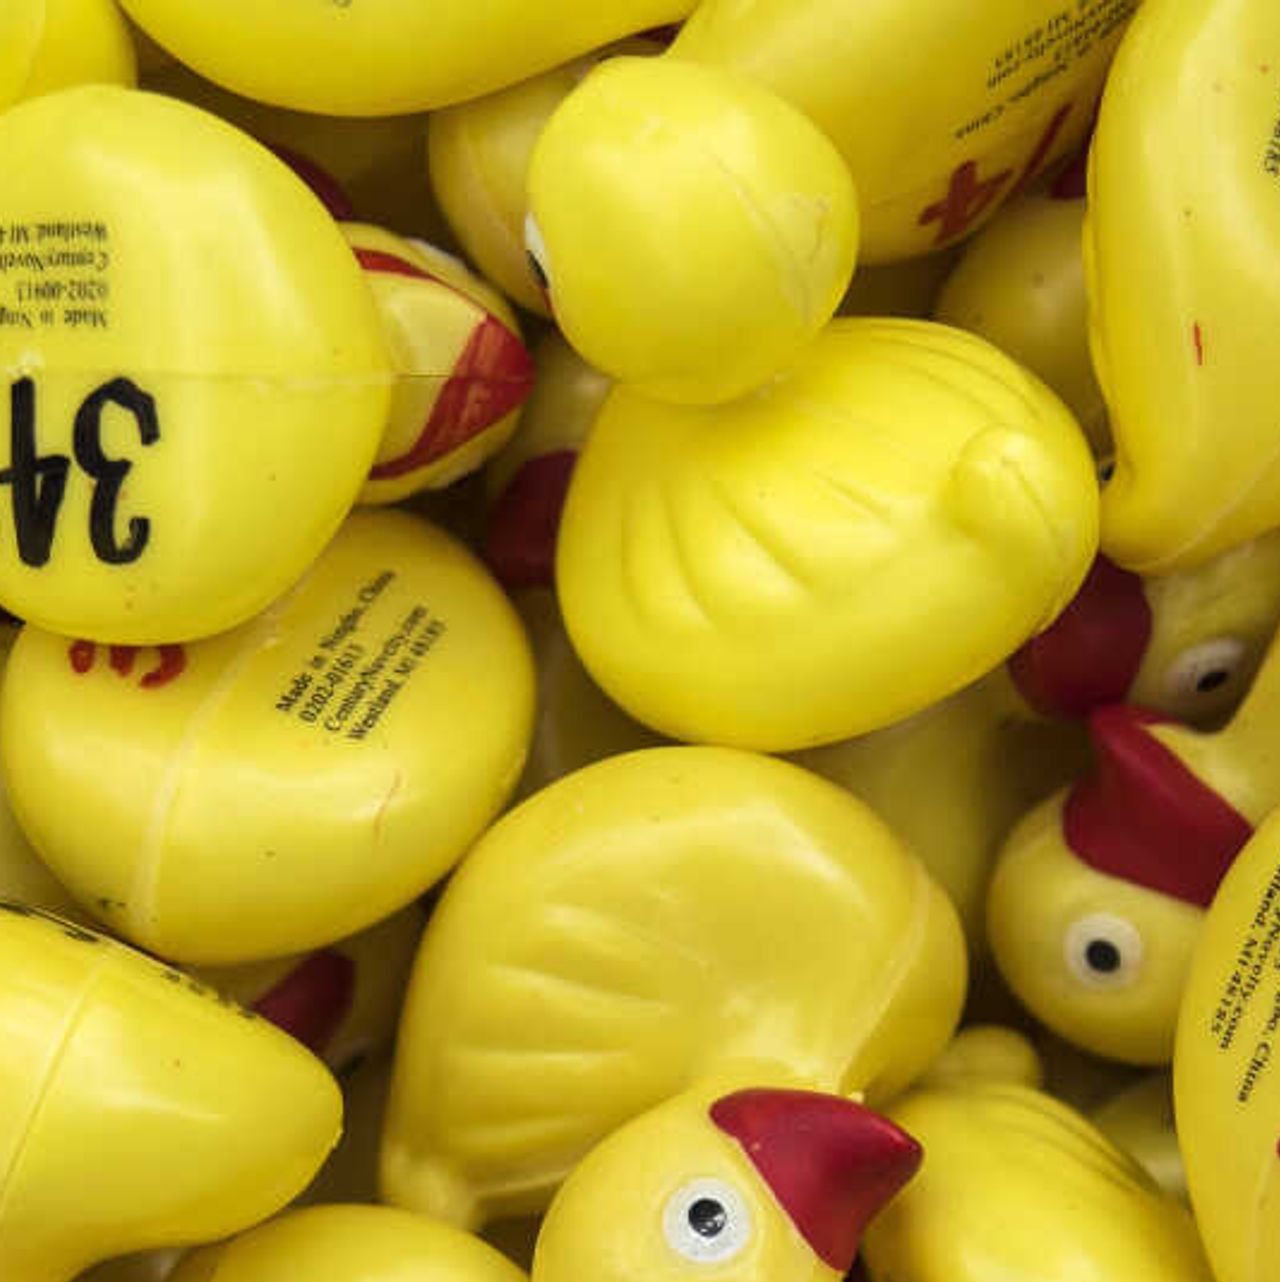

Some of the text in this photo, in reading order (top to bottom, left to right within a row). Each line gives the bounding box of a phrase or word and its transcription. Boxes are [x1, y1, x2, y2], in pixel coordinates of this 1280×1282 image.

[275, 672, 313, 711] Made
[1210, 970, 1242, 1033] 48185
[1237, 1041, 1270, 1102] China
